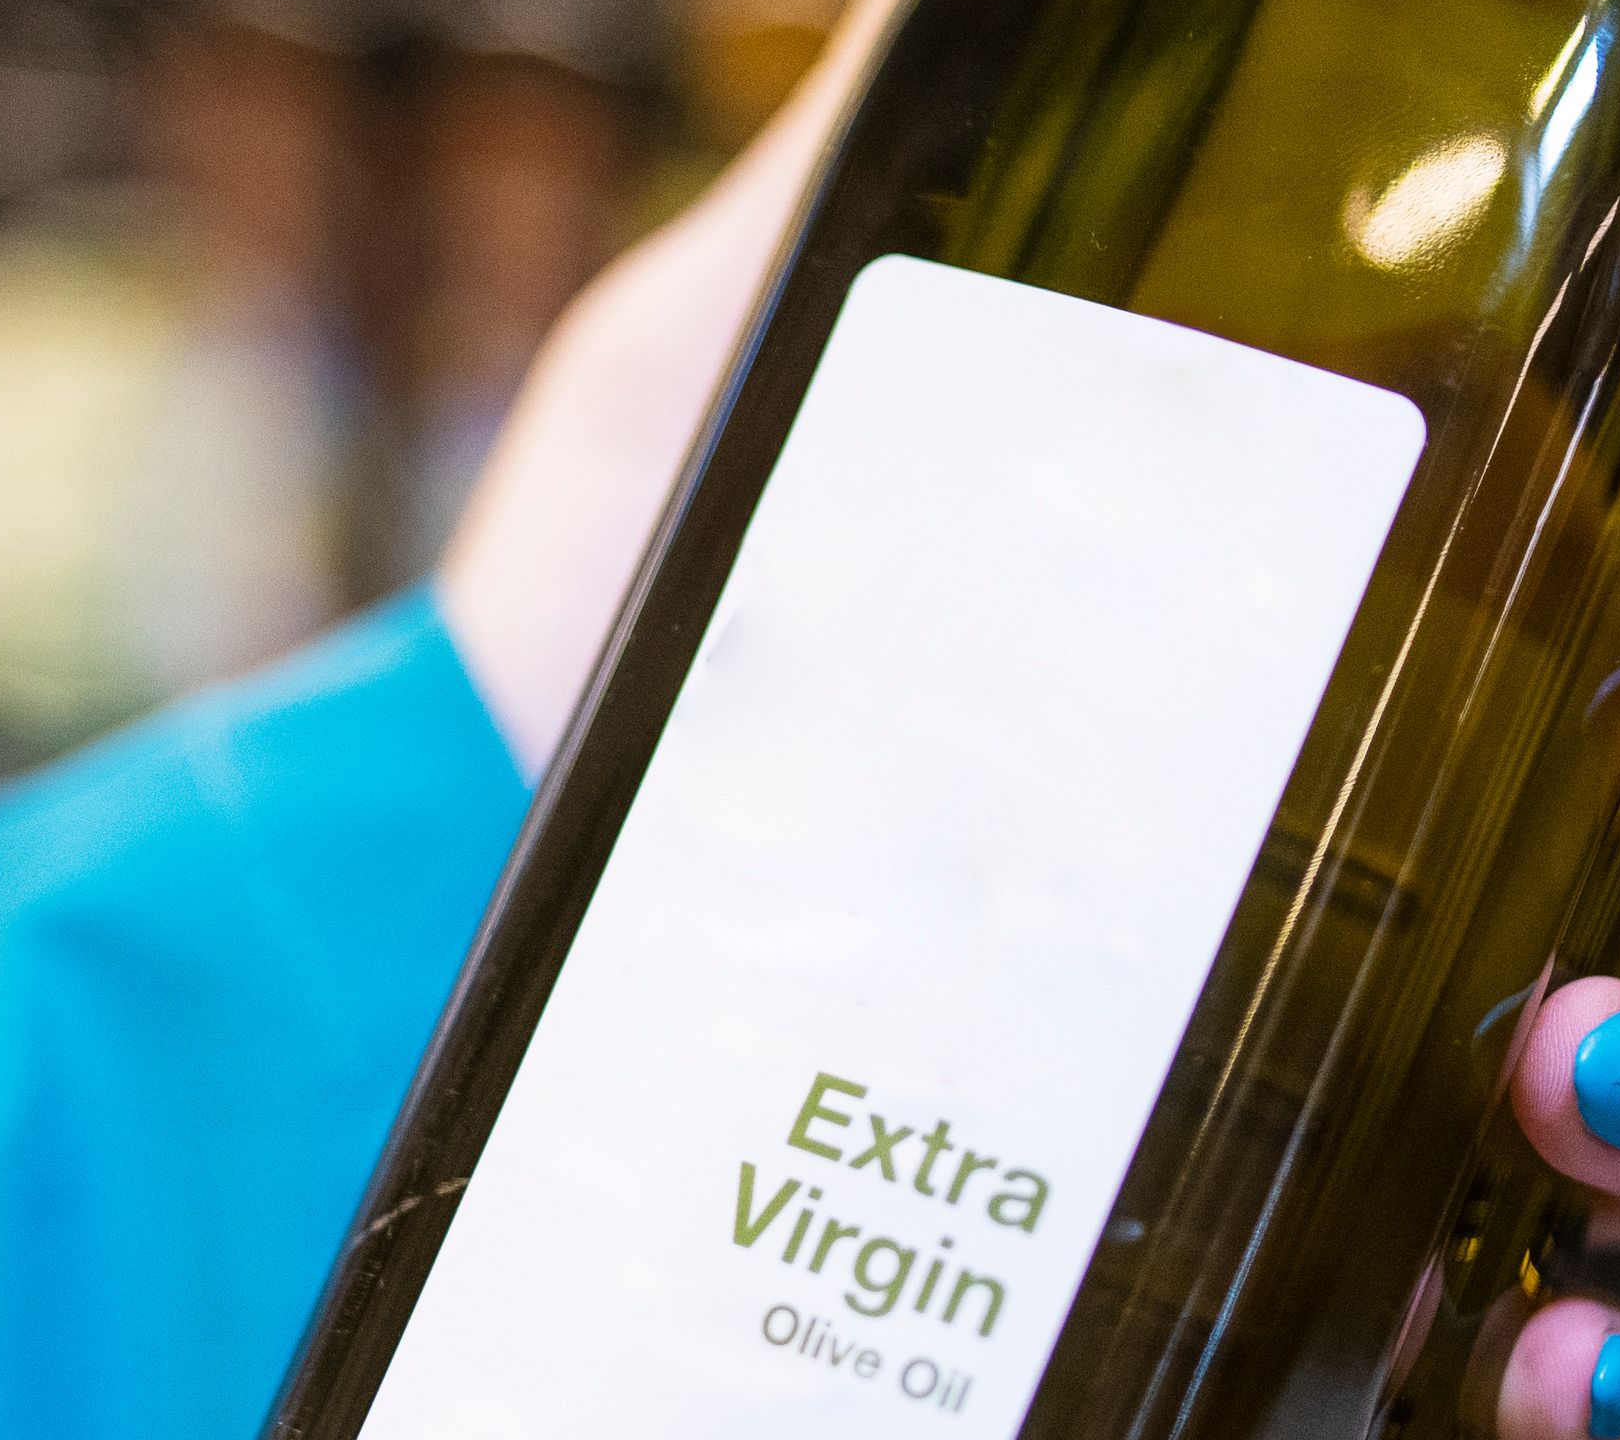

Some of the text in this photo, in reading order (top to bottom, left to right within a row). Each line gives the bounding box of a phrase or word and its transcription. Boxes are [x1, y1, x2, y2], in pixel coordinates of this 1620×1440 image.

[786, 1070, 1051, 1234] Extra
[732, 1160, 1007, 1338] Virgin
[762, 1303, 973, 1414] Olive Oil
